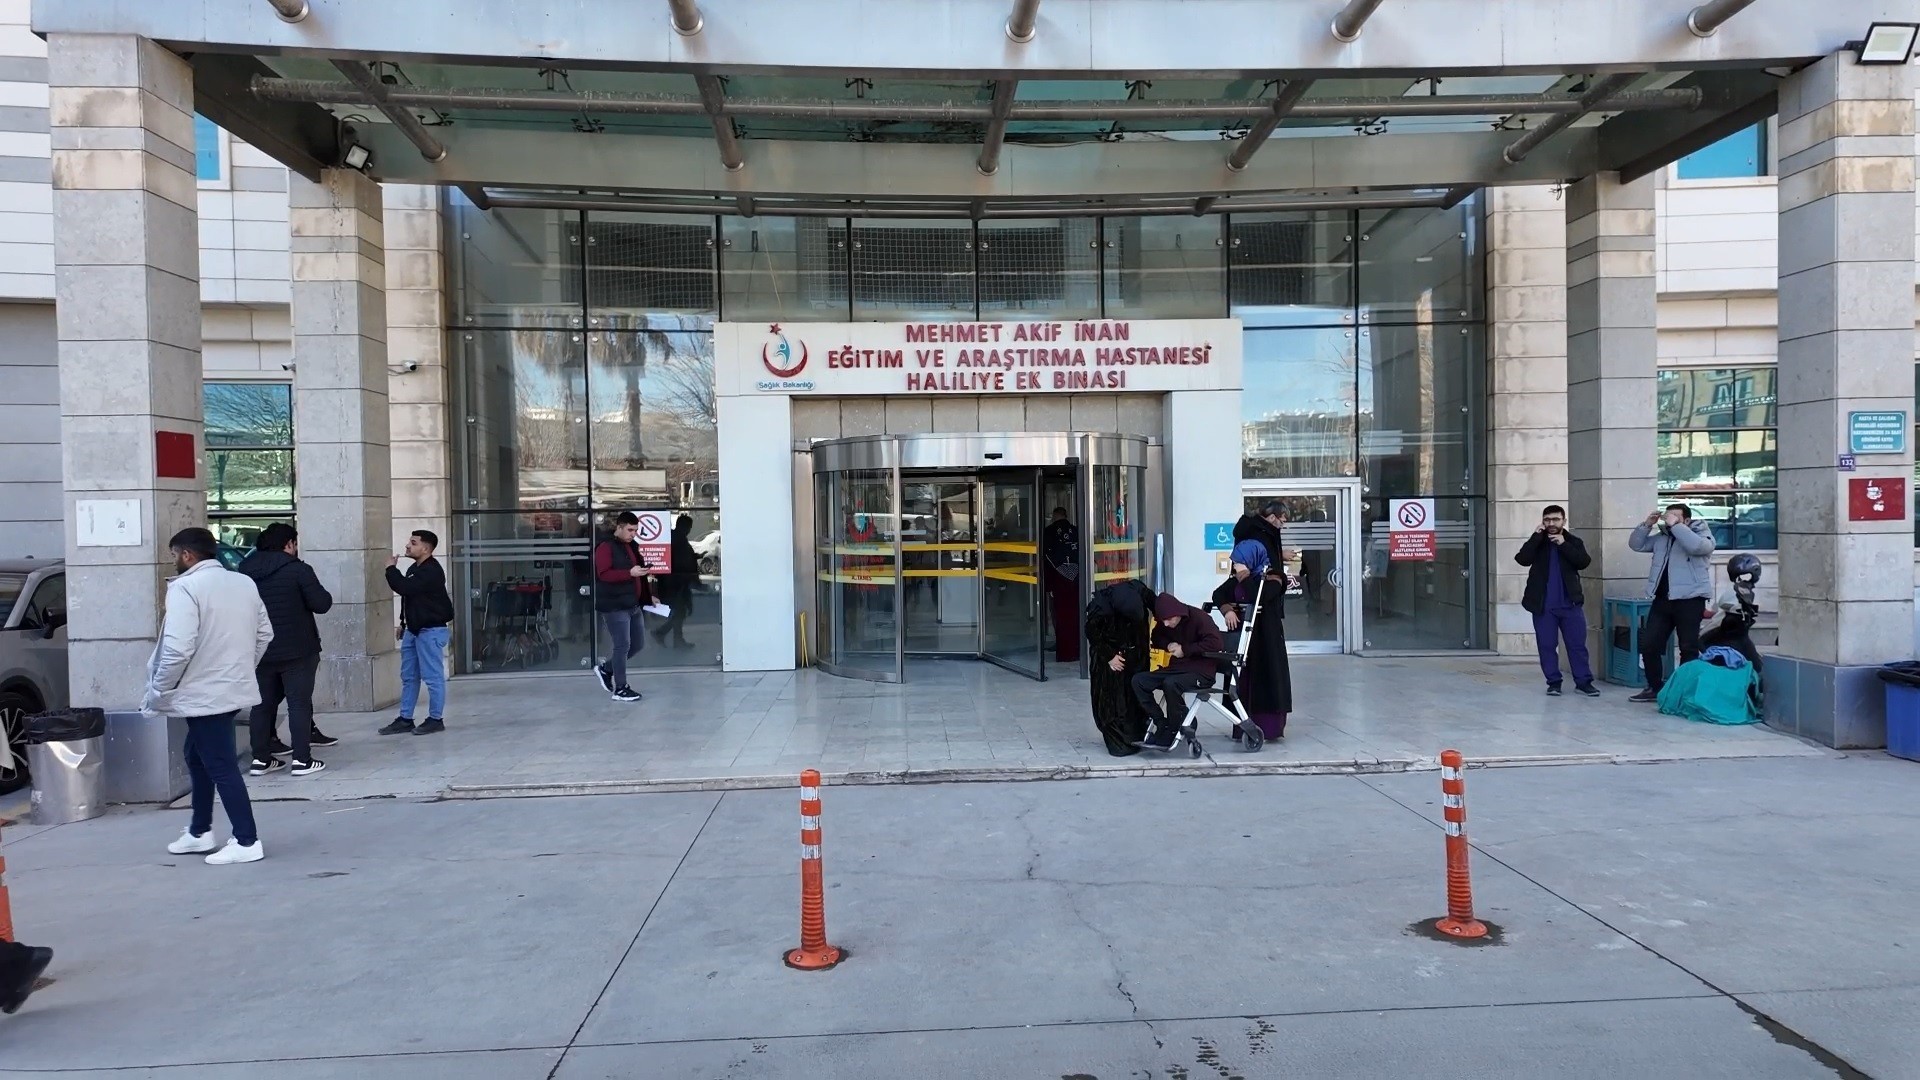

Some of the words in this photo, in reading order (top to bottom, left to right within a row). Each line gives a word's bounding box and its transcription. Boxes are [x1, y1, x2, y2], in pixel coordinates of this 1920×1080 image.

[906, 323, 1002, 342] MEHMET
[1013, 323, 1062, 342] AKİF
[1075, 323, 1130, 342] İNAN
[916, 349, 944, 368] VE
[956, 348, 1086, 371] ARAŞTIRMA
[1096, 345, 1211, 366] HASTANESİ
[907, 371, 1005, 391] HALİLİYE
[1016, 371, 1041, 390] EK
[1053, 370, 1126, 389] BİNASI
